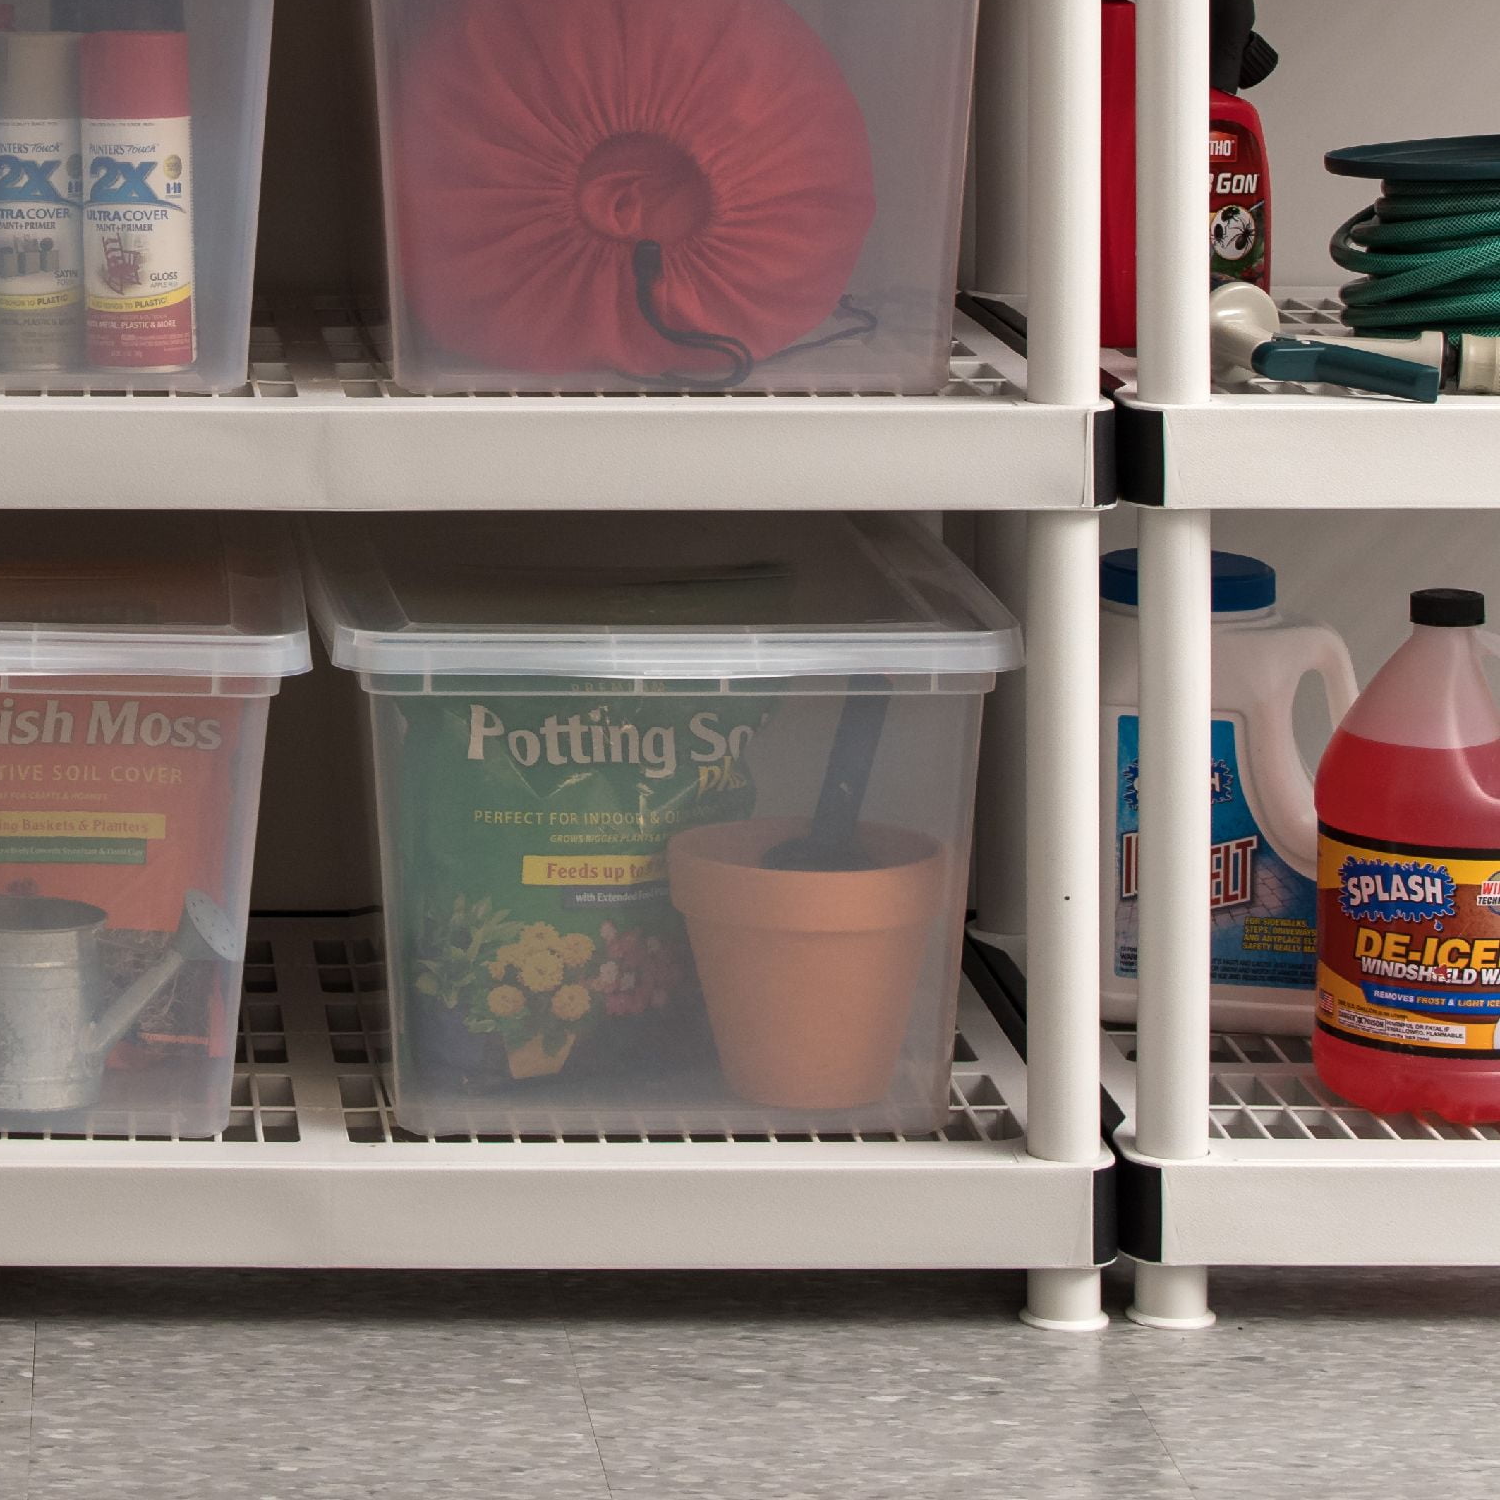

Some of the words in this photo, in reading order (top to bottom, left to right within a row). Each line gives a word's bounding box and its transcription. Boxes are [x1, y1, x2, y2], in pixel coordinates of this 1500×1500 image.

[90, 156, 158, 201] 2X
[1216, 172, 1258, 194] GON
[26, 208, 70, 220] COVER
[86, 210, 121, 221] ULTRA
[123, 209, 168, 221] COVER
[53, 269, 78, 279] SATIN
[150, 271, 178, 282] GLOSS
[86, 699, 223, 751] Moss
[467, 703, 677, 779] Potting
[52, 764, 102, 782] SOIL
[111, 764, 183, 785] COVER
[22, 818, 75, 832] Baskets
[78, 819, 90, 832] &
[92, 819, 149, 834] Planters
[473, 810, 544, 825] PERFECT
[550, 812, 578, 826] FOR
[584, 811, 644, 826] INDOOR
[650, 810, 660, 825] &
[546, 862, 599, 880] Feeds
[603, 865, 625, 882] up
[575, 891, 596, 902] with
[597, 890, 638, 902] Extended
[1347, 874, 1444, 906] SPLASH
[1478, 896, 1500, 905] TECH
[1245, 917, 1261, 925] FOR
[1244, 934, 1259, 942] AND
[1242, 942, 1271, 951] SAFETY
[1355, 927, 1500, 970] DE-ICE
[1374, 989, 1414, 1003] REMOVES
[1416, 996, 1446, 1006] FROST
[1458, 999, 1484, 1008] LIGHT
[1487, 1000, 1500, 1008] ICE
